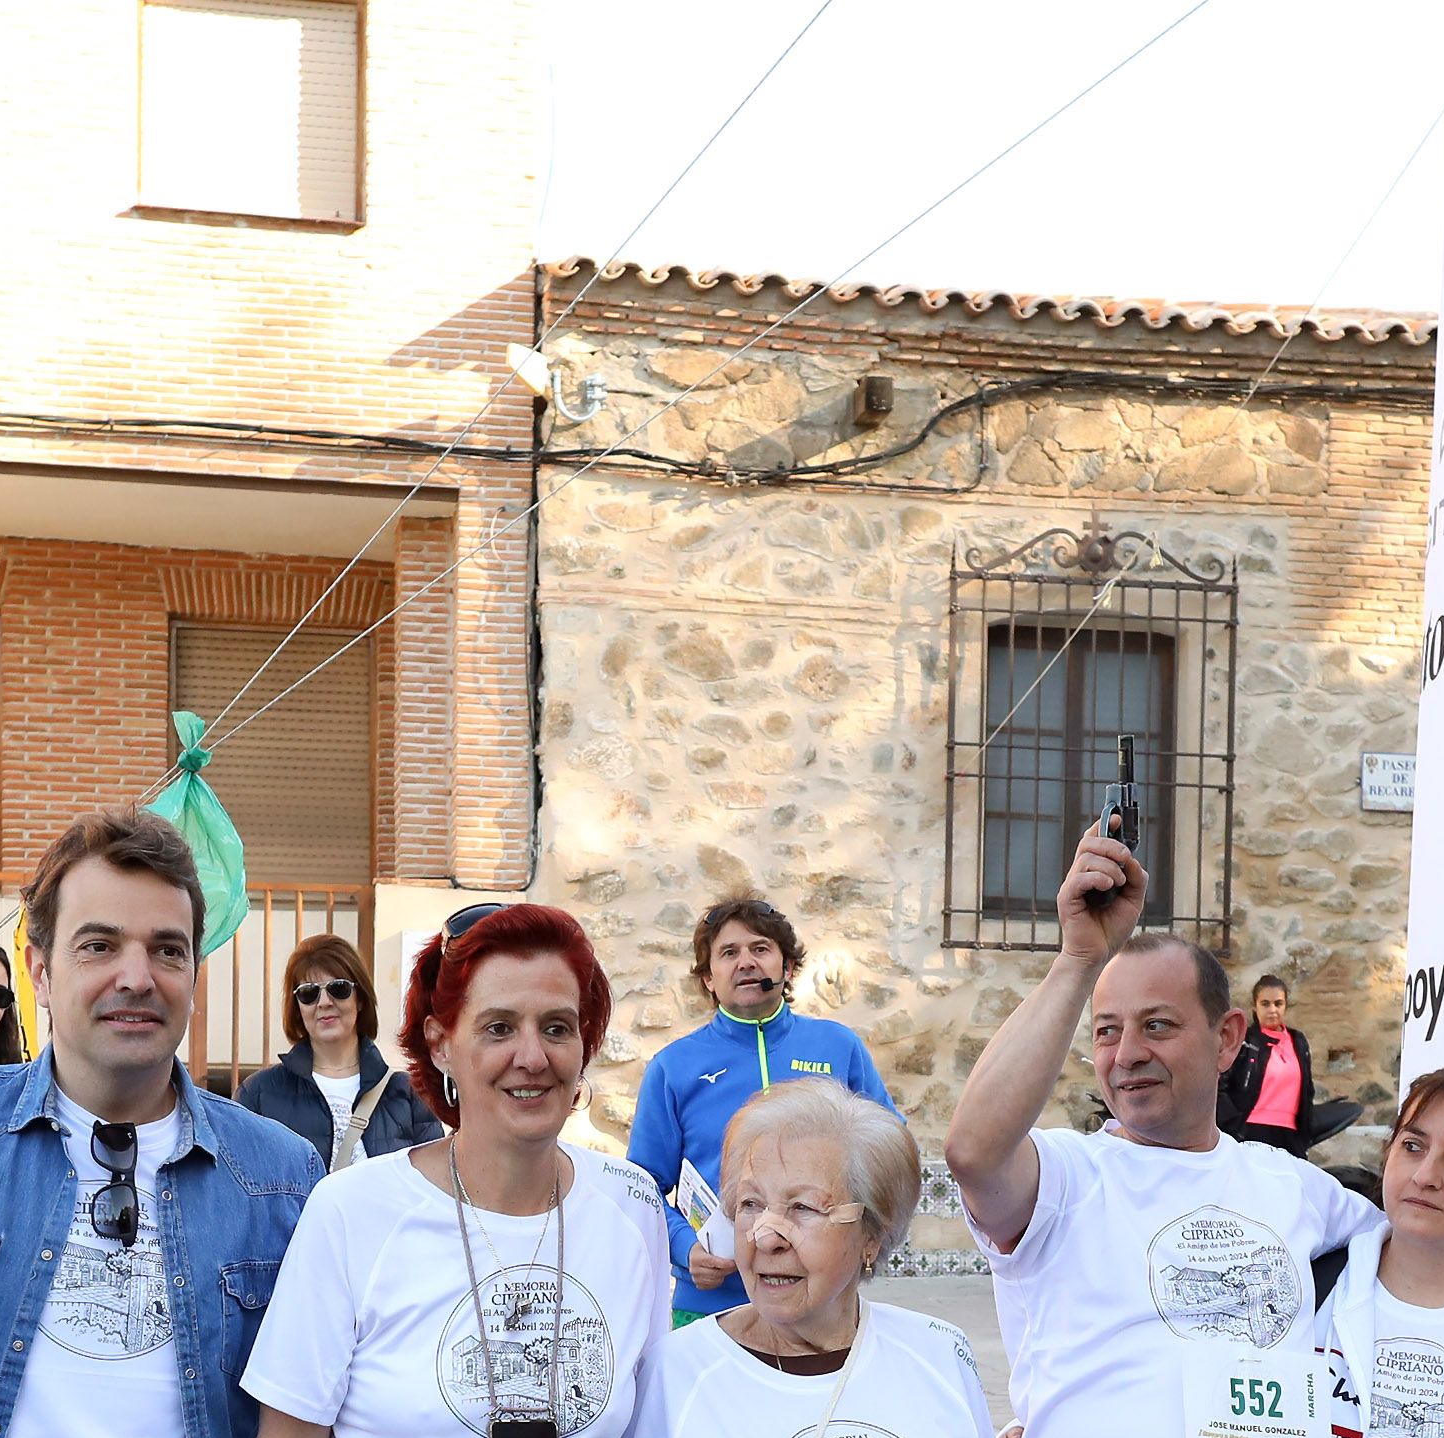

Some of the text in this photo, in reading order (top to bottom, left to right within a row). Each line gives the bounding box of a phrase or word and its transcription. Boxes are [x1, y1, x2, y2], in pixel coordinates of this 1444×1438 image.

[1392, 773, 1409, 784] DE
[1369, 785, 1415, 797] RECARE
[790, 1059, 832, 1075] BIKILA
[1190, 1220, 1241, 1229] MEMORIAL
[1181, 1228, 1244, 1241] CIPRIANO
[1187, 1243, 1208, 1251] Amigo
[1219, 1241, 1230, 1249] los
[1187, 1255, 1196, 1263] 14
[1207, 1254, 1227, 1263] Abril
[1229, 1252, 1248, 1261] 2024
[494, 1281, 557, 1293] I MEMORIA
[490, 1324, 500, 1333] 14
[539, 1322, 555, 1331] 202
[1389, 1351, 1444, 1364] MEMORIAL
[1376, 1356, 1444, 1376] CIPRIANO
[1376, 1368, 1402, 1380] Amigo
[1403, 1373, 1412, 1381] de
[1306, 1373, 1315, 1418] MARCHA
[1394, 1385, 1417, 1395] Abril
[1419, 1388, 1439, 1397] 2024
[1229, 1377, 1284, 1418] 552
[1208, 1421, 1307, 1437] JOSE MANUEL GONZALEZ
